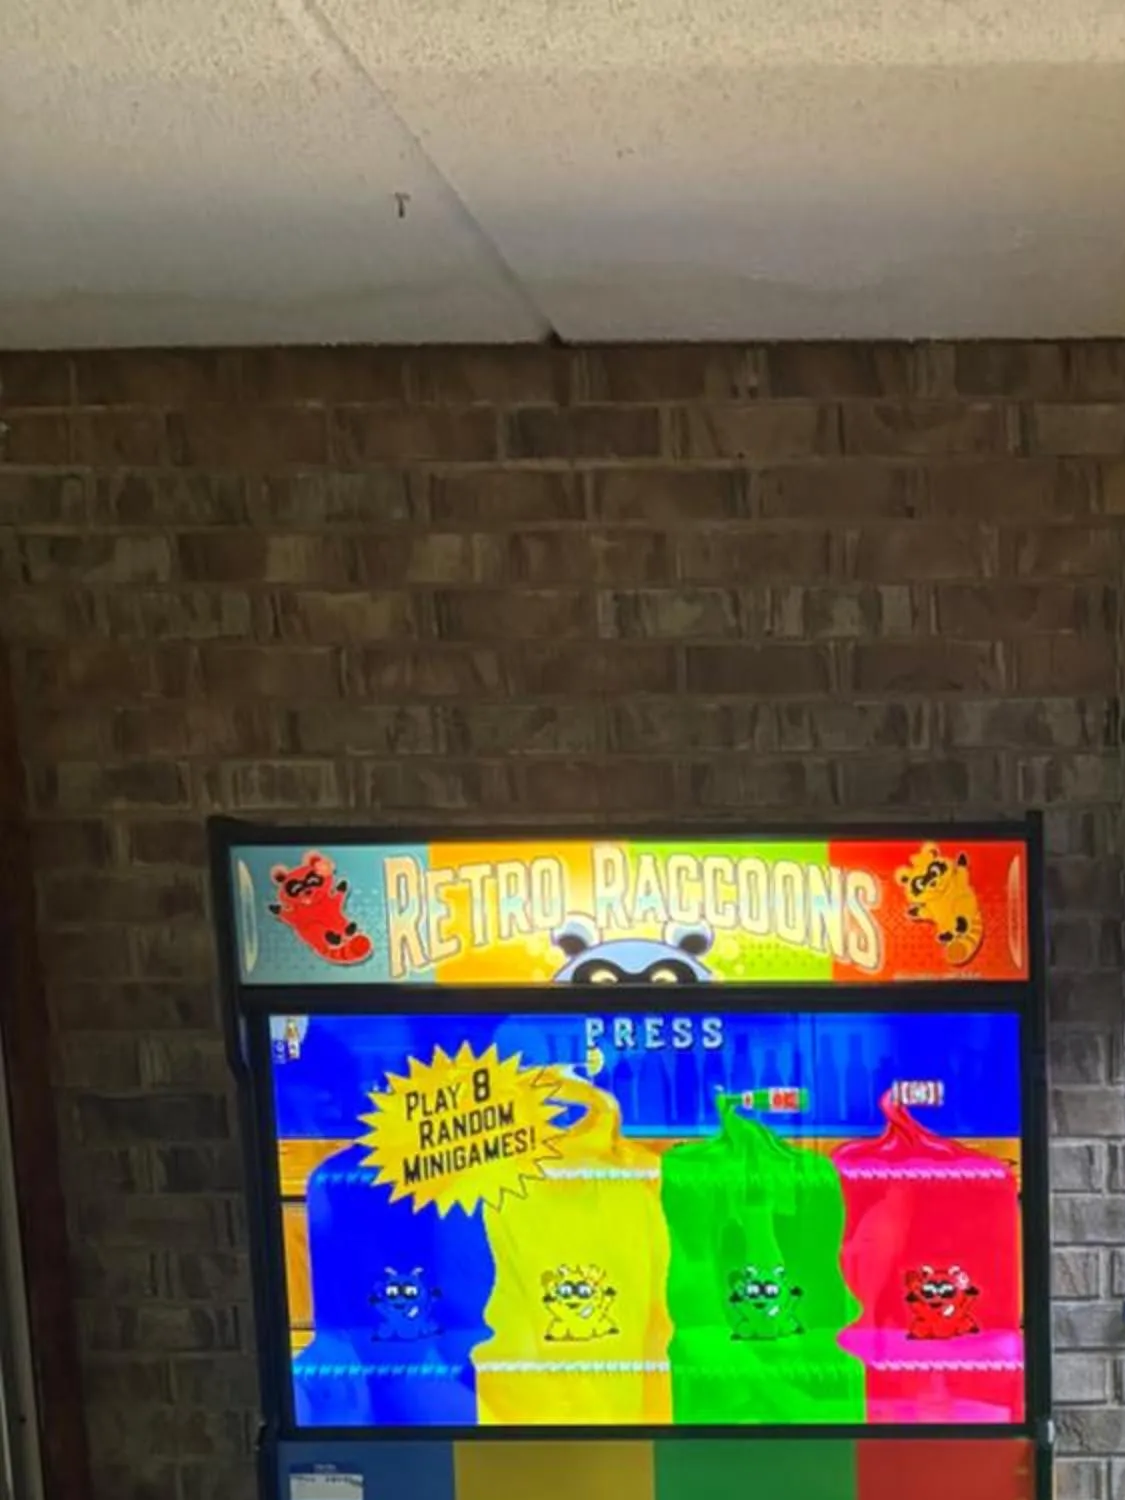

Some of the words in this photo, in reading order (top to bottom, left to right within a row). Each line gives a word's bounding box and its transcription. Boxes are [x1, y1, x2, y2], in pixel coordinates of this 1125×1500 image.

[384, 855, 565, 981] RETRO
[591, 841, 882, 971] RACCOONS
[585, 1017, 724, 1049] PRESS
[405, 1083, 462, 1120] PLAY
[472, 1068, 491, 1102] 8
[419, 1101, 515, 1150] RANDOM
[403, 1126, 537, 1185] MINIGAMES!
